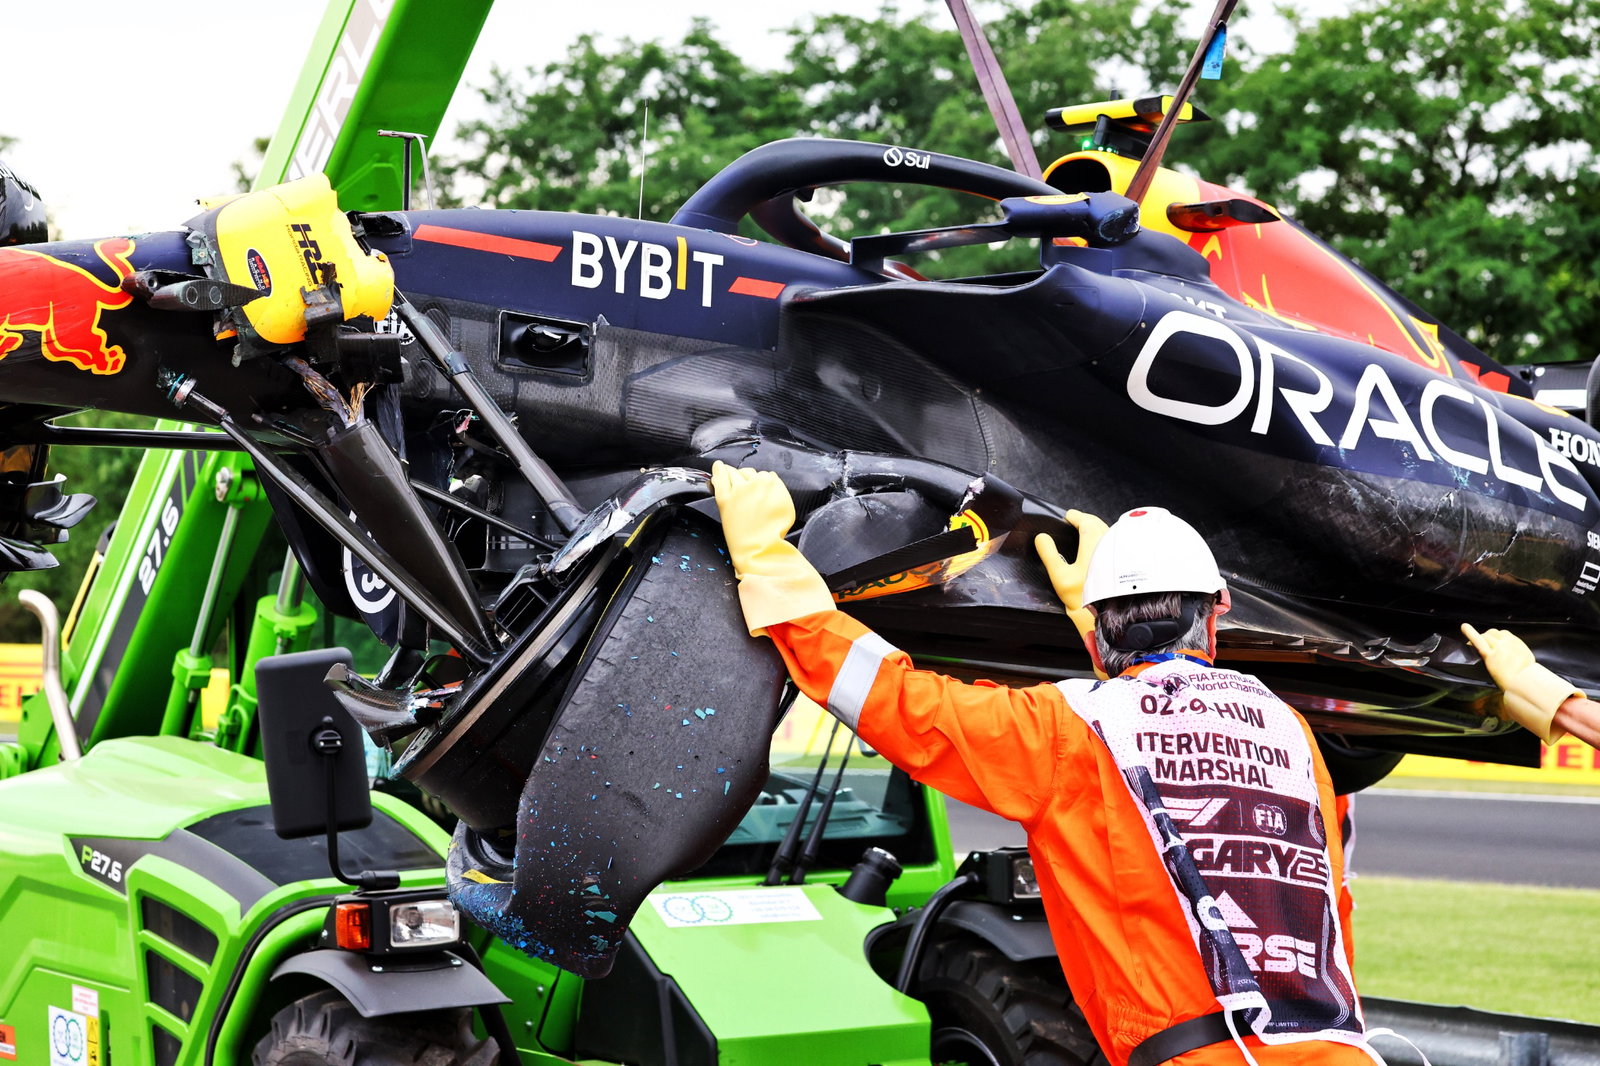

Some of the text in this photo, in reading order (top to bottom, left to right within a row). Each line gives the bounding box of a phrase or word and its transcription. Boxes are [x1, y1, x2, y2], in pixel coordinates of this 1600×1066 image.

[288, 0, 395, 178] ERL
[571, 230, 724, 308] BYBIT
[1127, 310, 1588, 512] ORACLE
[138, 496, 179, 596] 27.6
[1192, 681, 1229, 691] World
[1155, 757, 1273, 789] MARSHAL
[81, 845, 123, 883] P27.6
